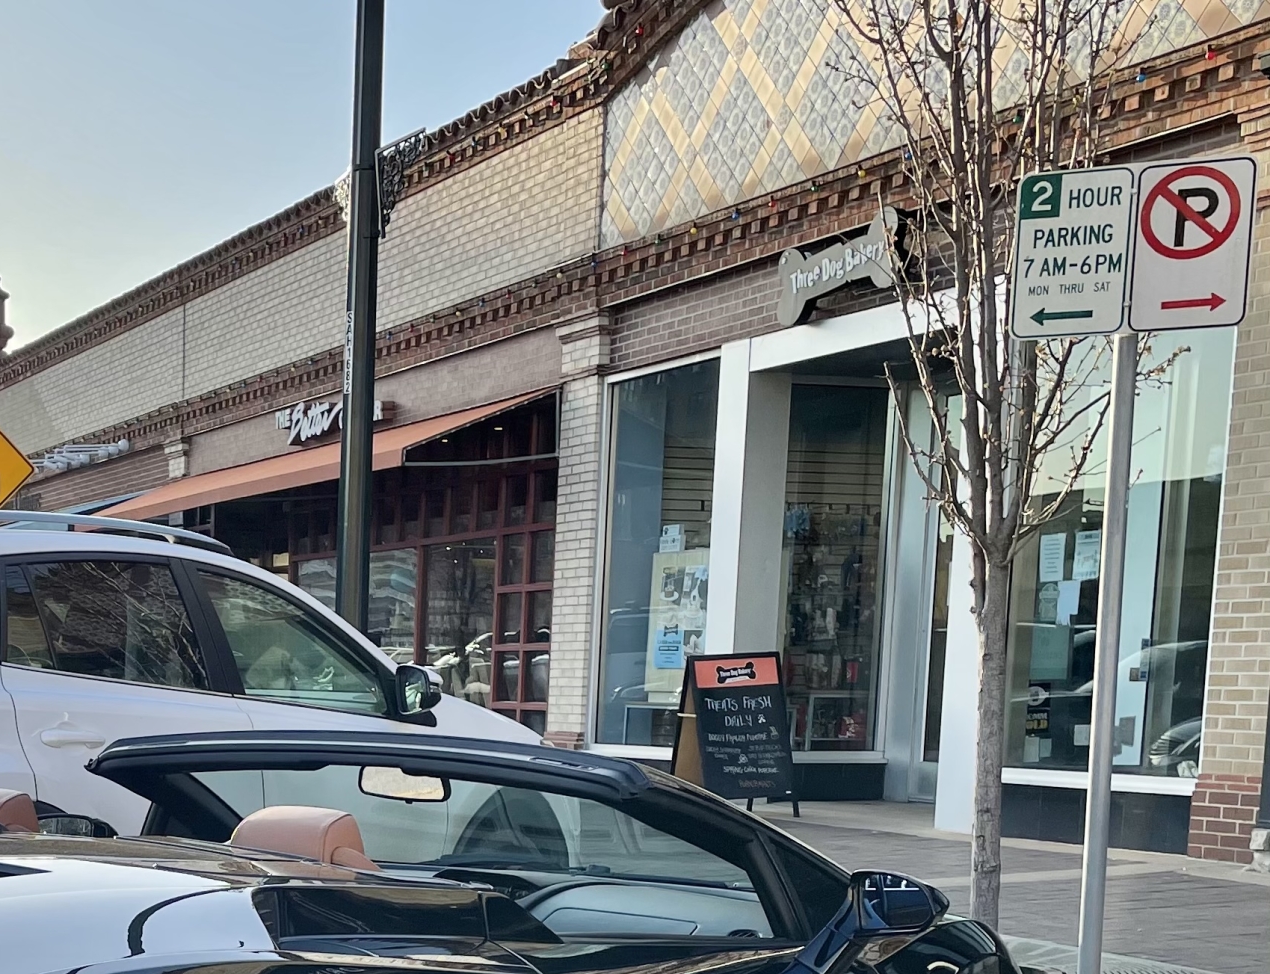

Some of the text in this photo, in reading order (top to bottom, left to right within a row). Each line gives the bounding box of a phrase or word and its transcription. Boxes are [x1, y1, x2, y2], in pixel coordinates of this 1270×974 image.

[1030, 180, 1123, 212] 2 HOUR
[1033, 223, 1114, 249] PARKING
[790, 240, 886, 294] Three Dog Bakery
[1028, 281, 1111, 297] MON THRU SAT
[275, 408, 291, 430] THE
[704, 695, 772, 712] TREATS FRESH
